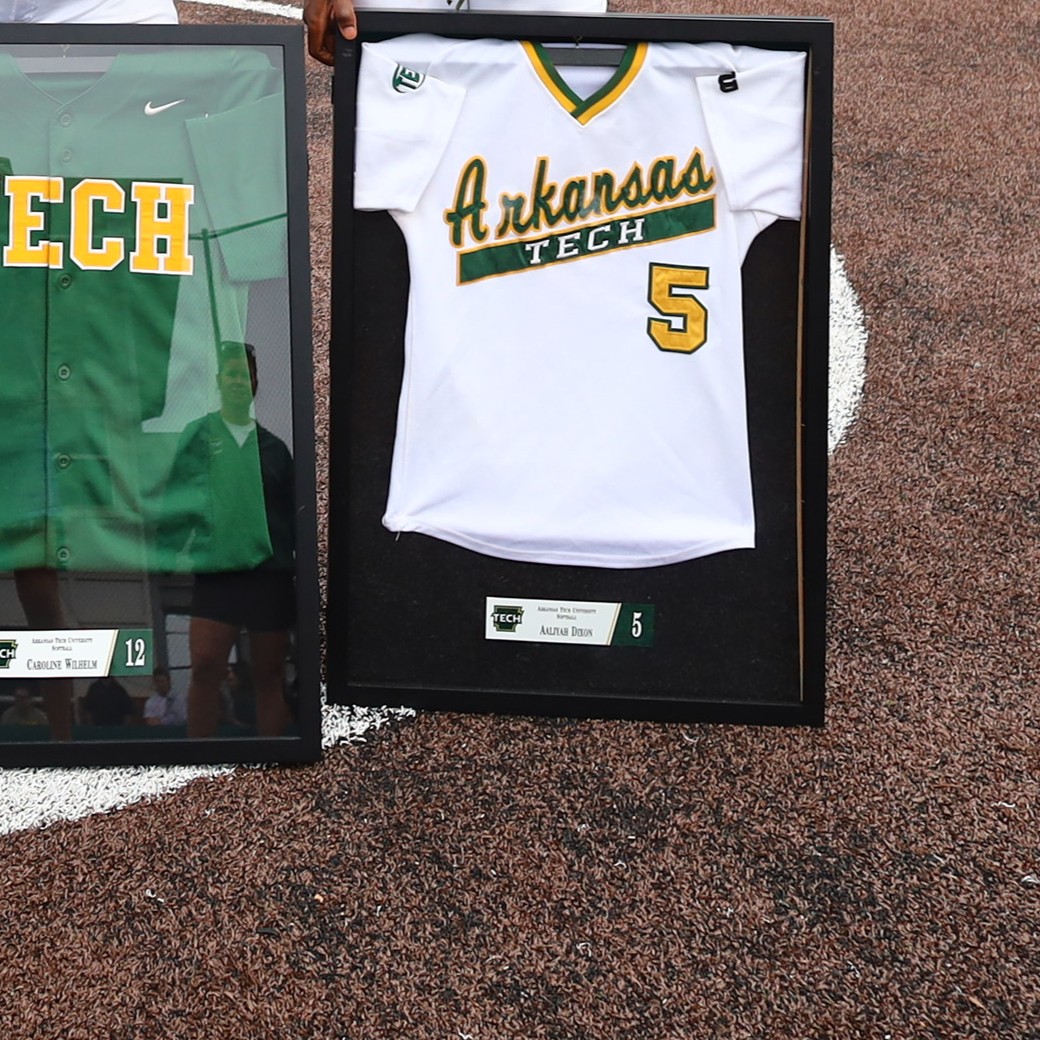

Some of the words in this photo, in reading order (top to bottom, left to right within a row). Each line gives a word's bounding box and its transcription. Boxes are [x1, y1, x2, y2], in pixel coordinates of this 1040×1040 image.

[443, 146, 717, 248] Arkansas
[524, 217, 646, 265] TECH
[646, 261, 710, 355] 5
[492, 613, 522, 624] TECH
[631, 612, 643, 638] 5
[26, 658, 62, 670] CAROLINE
[65, 658, 98, 670] WILHELM
[125, 638, 146, 667] 12
